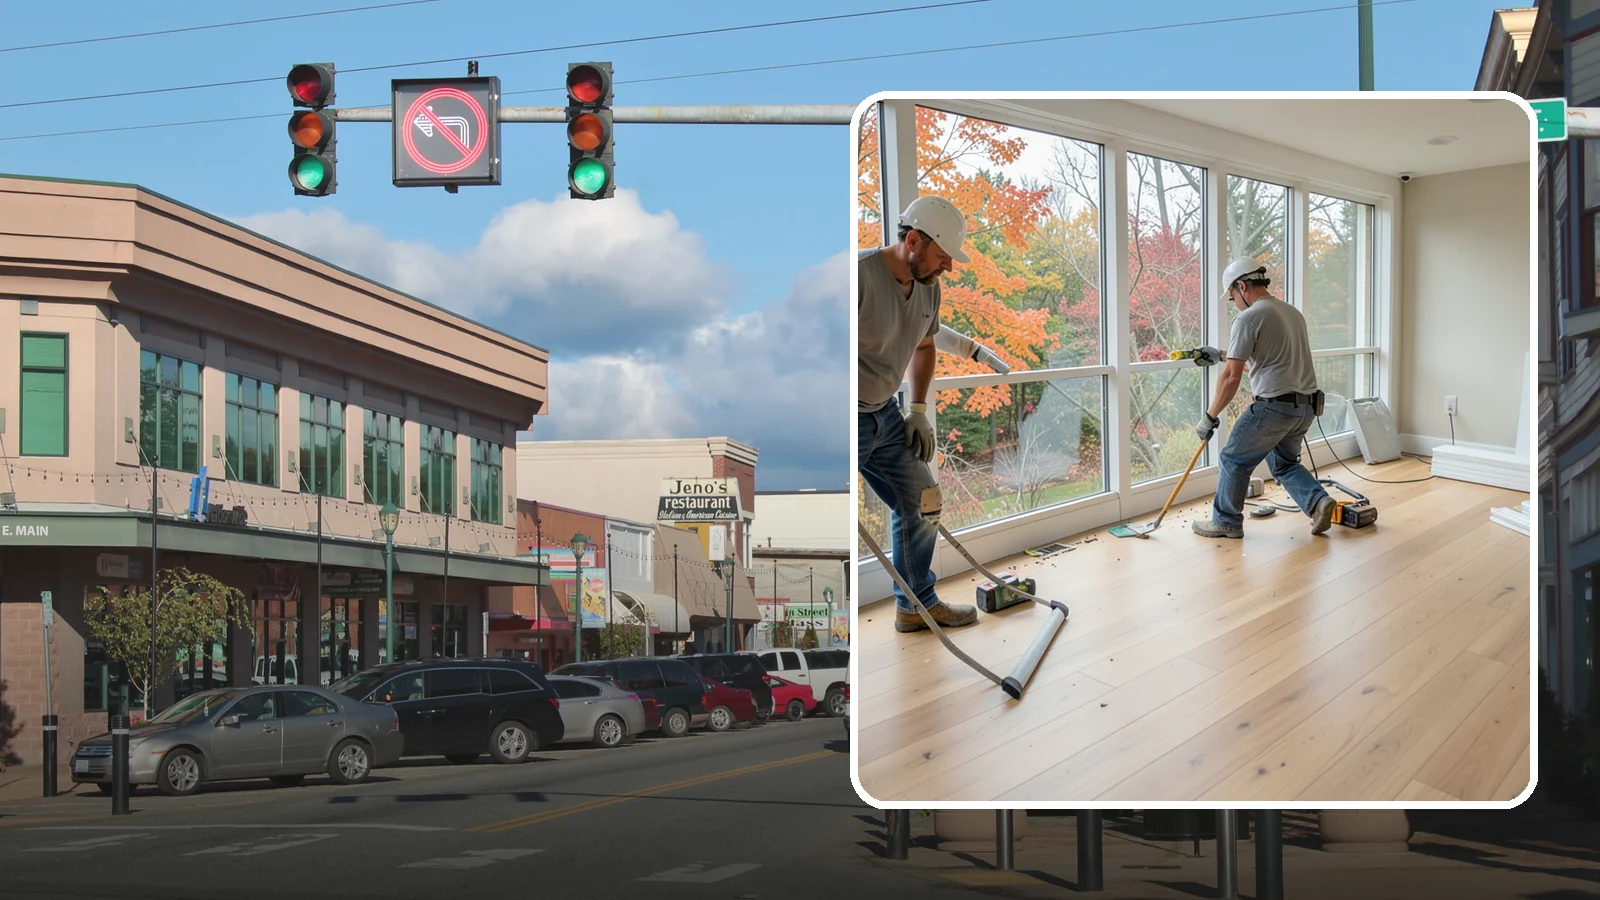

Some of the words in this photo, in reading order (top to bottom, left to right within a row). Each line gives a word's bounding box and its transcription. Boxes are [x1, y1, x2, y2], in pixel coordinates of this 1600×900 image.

[670, 480, 727, 494] Jeno's
[665, 496, 731, 509] restaurant
[659, 510, 681, 519] Italian
[686, 510, 714, 519] American
[715, 510, 737, 519] Cuisine
[2, 525, 13, 536] E.
[15, 525, 49, 536] MAIN
[797, 607, 829, 616] Street
[791, 619, 824, 627] lass
